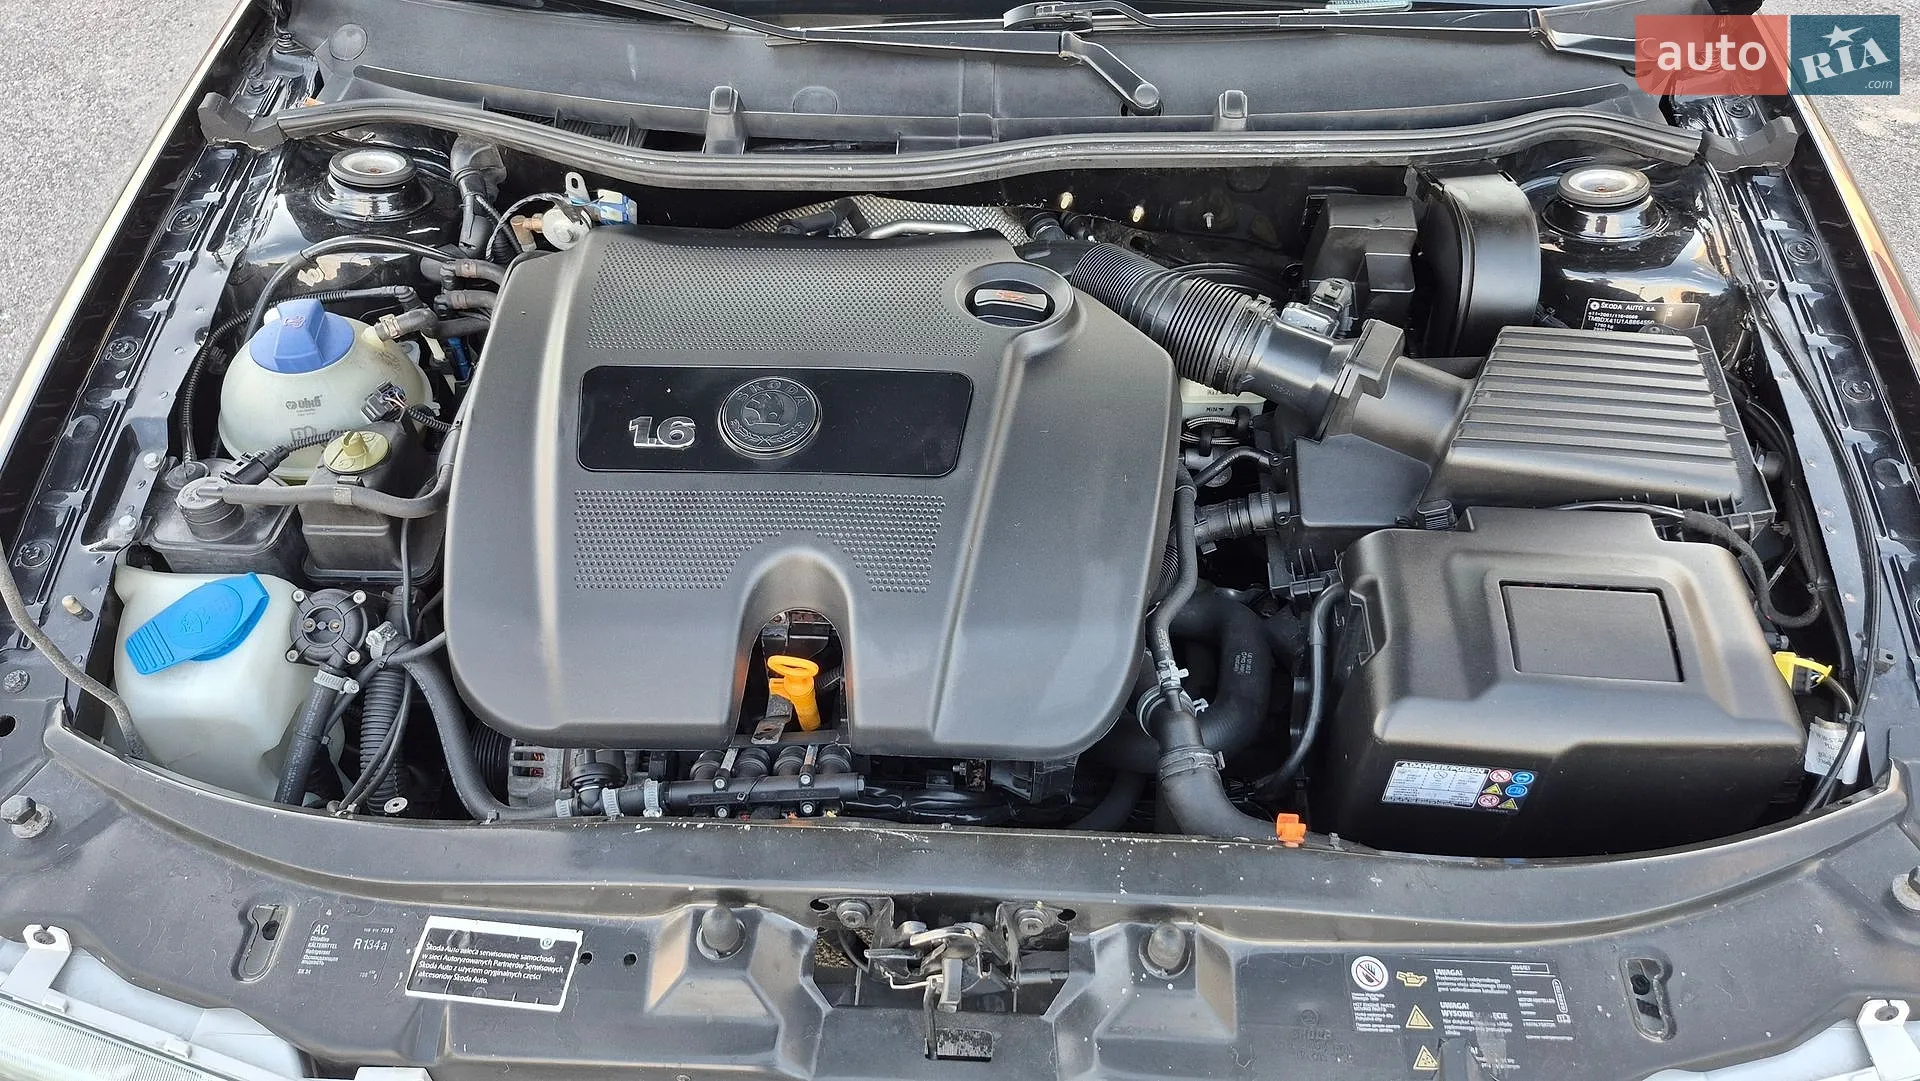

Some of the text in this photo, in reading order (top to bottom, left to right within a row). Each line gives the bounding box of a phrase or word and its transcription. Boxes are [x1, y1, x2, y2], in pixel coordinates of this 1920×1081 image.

[1625, 303, 1643, 311] AUTO
[628, 416, 696, 448] 1.6
[312, 924, 329, 935] AC
[445, 944, 459, 953] Auto
[460, 946, 478, 955] zaleca
[480, 949, 520, 960] serwisowanie
[520, 953, 556, 963] samochodu
[443, 954, 492, 967] Autoryzowanych
[493, 959, 525, 970] Partnerów
[525, 962, 564, 974] Serwisowych
[419, 971, 453, 980] akcesoriów
[438, 962, 453, 971] Auto
[458, 965, 483, 974] użyciem
[484, 968, 522, 979] oryginalnych
[1434, 968, 1463, 976] UWAGA!
[1440, 1001, 1470, 1010] UWAGA!
